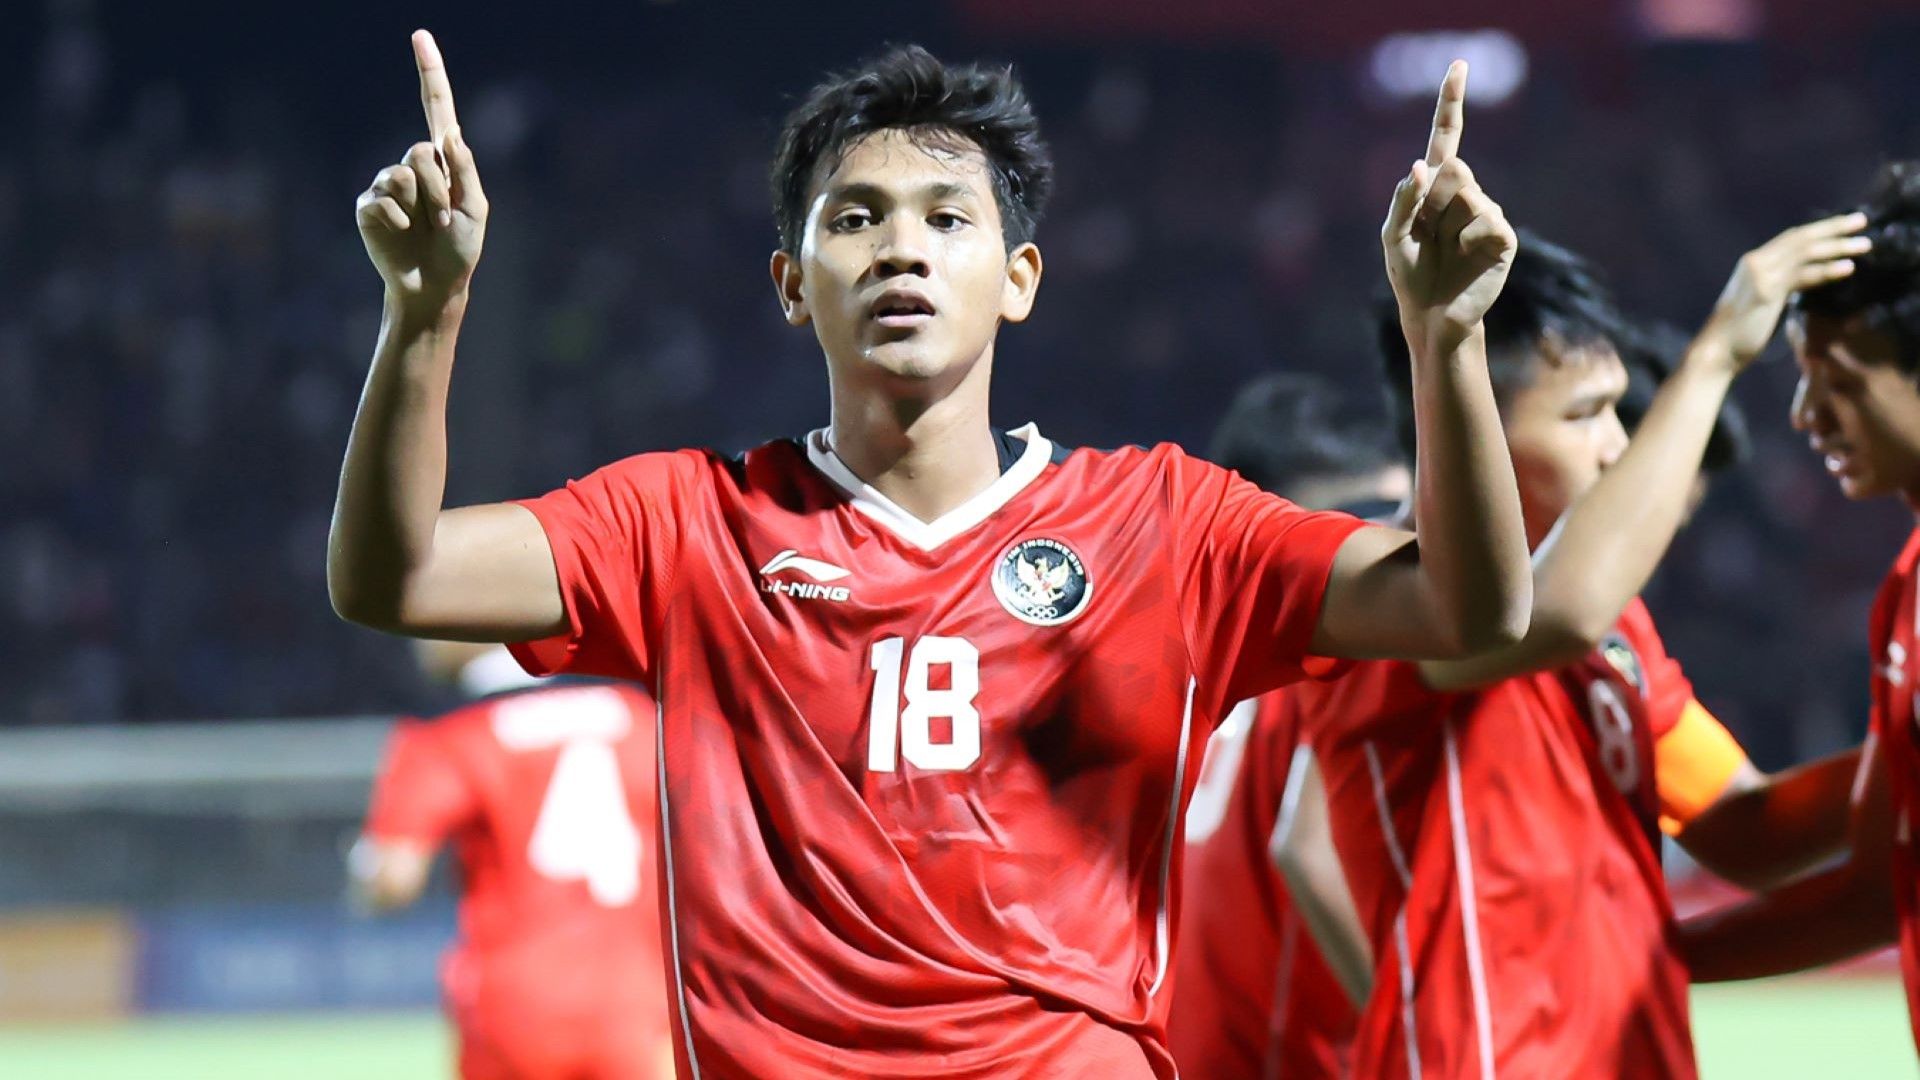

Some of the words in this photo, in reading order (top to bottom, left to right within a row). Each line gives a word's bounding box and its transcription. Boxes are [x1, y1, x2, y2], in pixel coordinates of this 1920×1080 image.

[1021, 538, 1084, 576] INDONESIA
[868, 635, 982, 773] 18
[1587, 679, 1640, 794] 8
[527, 740, 642, 907] 4
